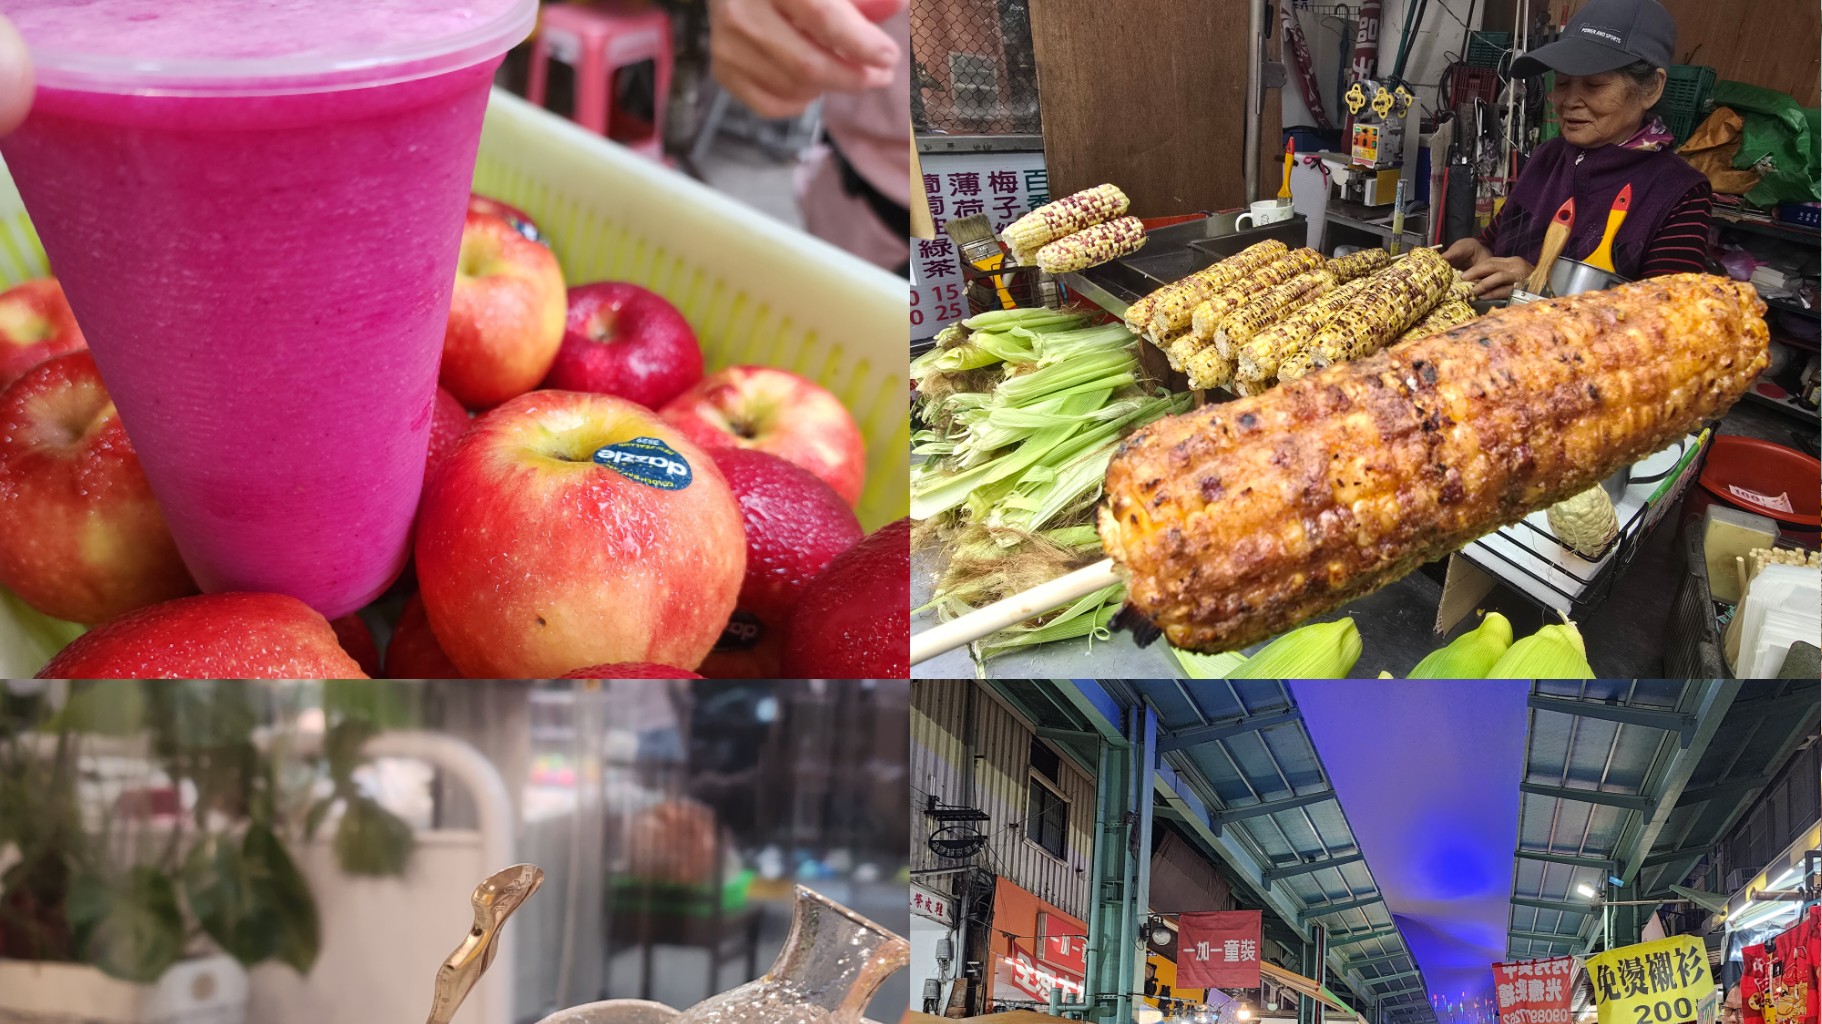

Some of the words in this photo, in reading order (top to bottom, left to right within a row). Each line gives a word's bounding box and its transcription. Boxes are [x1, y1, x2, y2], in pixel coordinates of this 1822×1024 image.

[932, 283, 960, 302] 15
[936, 302, 963, 322] 25
[597, 449, 688, 476] dazzle
[1183, 938, 1256, 963] 一加一童裝
[1597, 946, 1705, 1005] 免燙襯衫
